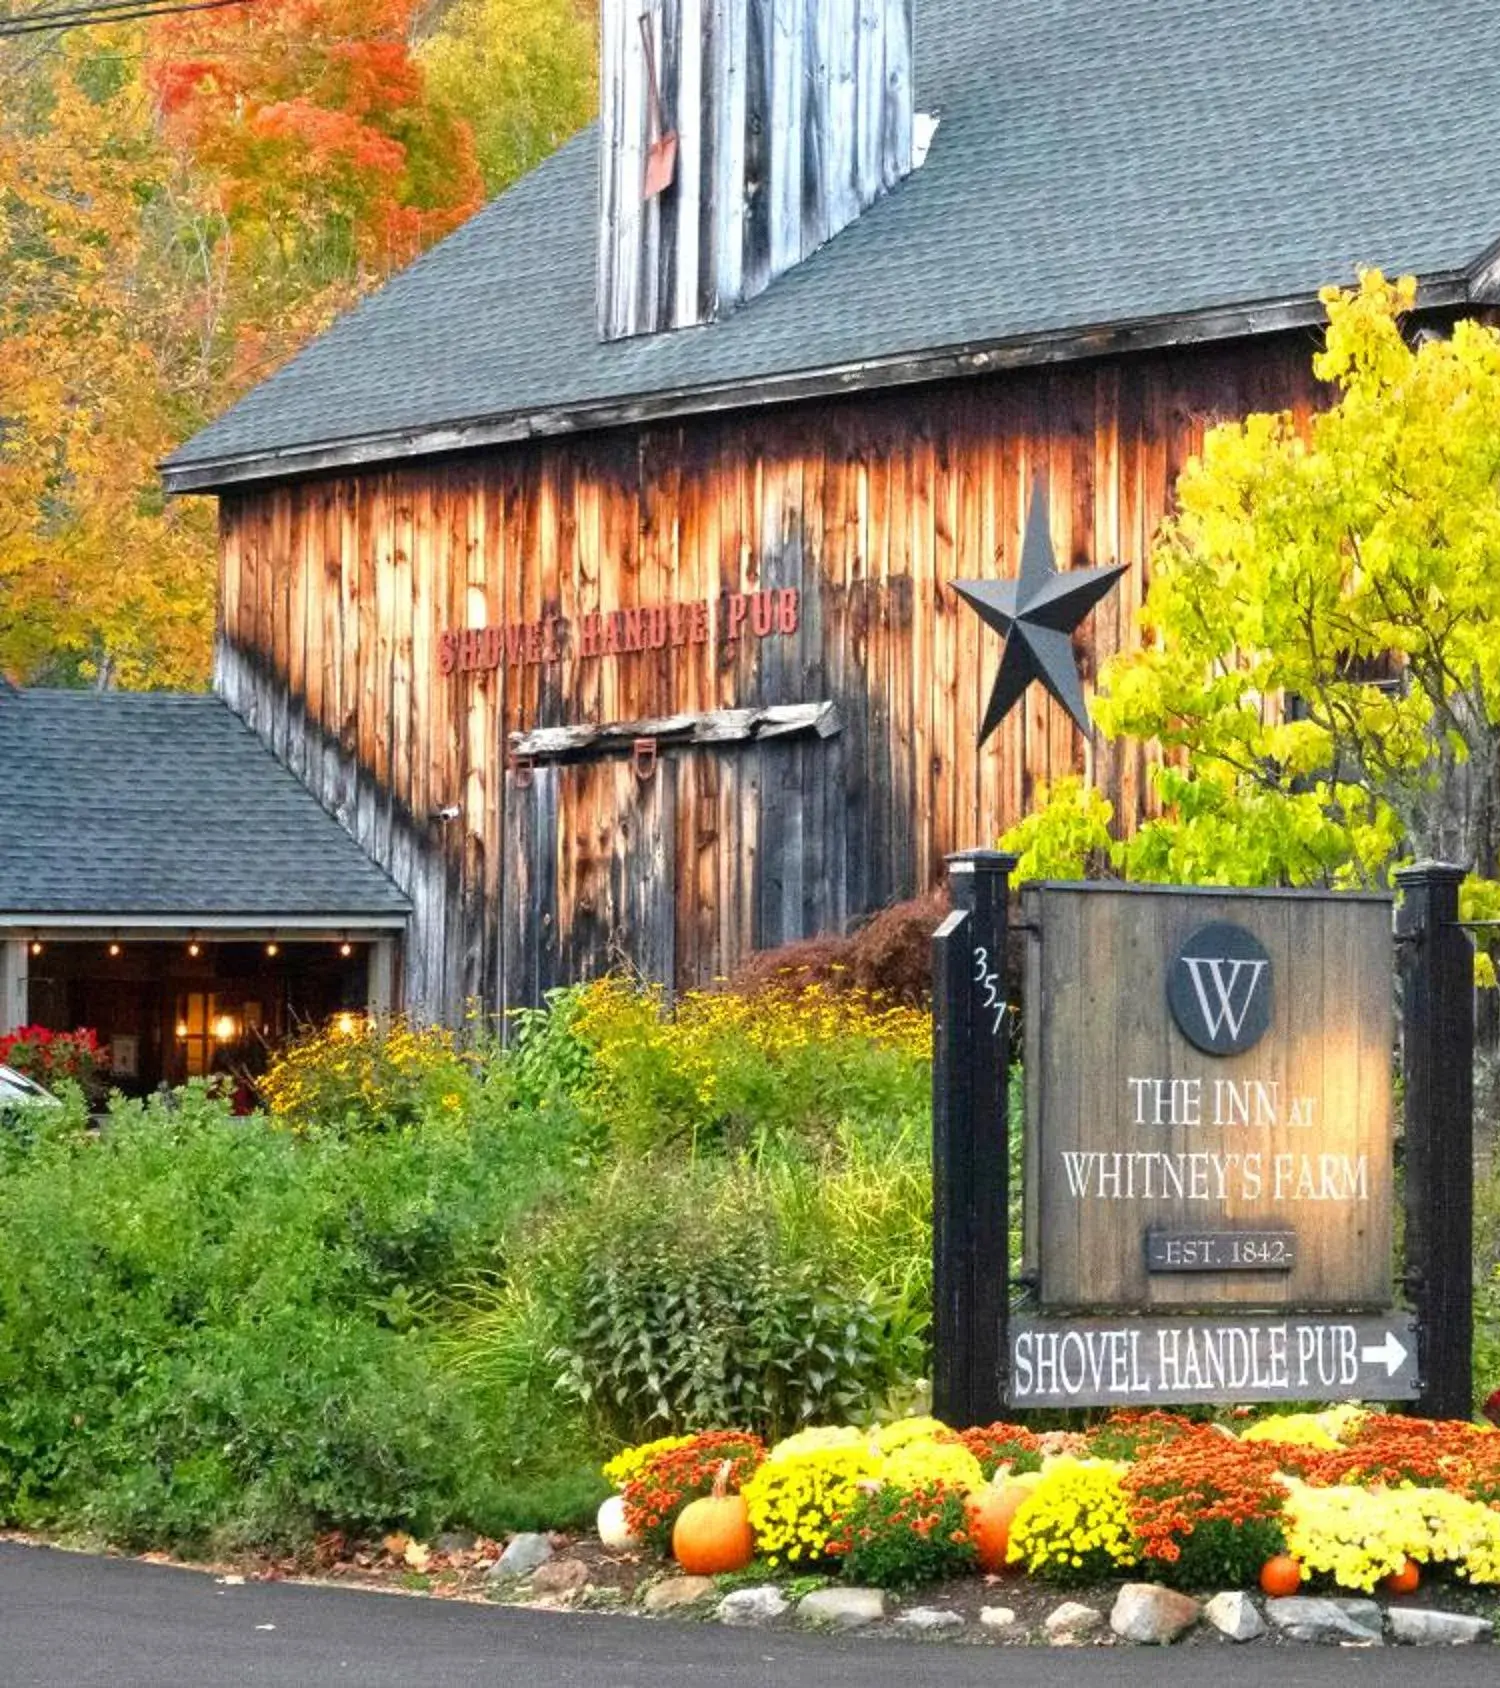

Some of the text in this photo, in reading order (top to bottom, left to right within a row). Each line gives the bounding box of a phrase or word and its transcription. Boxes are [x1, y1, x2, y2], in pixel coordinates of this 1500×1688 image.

[440, 588, 798, 676] SHOVEL HANDLE PUB
[973, 946, 1004, 1036] 357
[1181, 957, 1267, 1041] W
[1128, 1077, 1314, 1126] THE INN AT
[1061, 1151, 1369, 1201] WHITNEY'S FARM
[1015, 1324, 1359, 1397] SHOVEL HANDLE PUB
